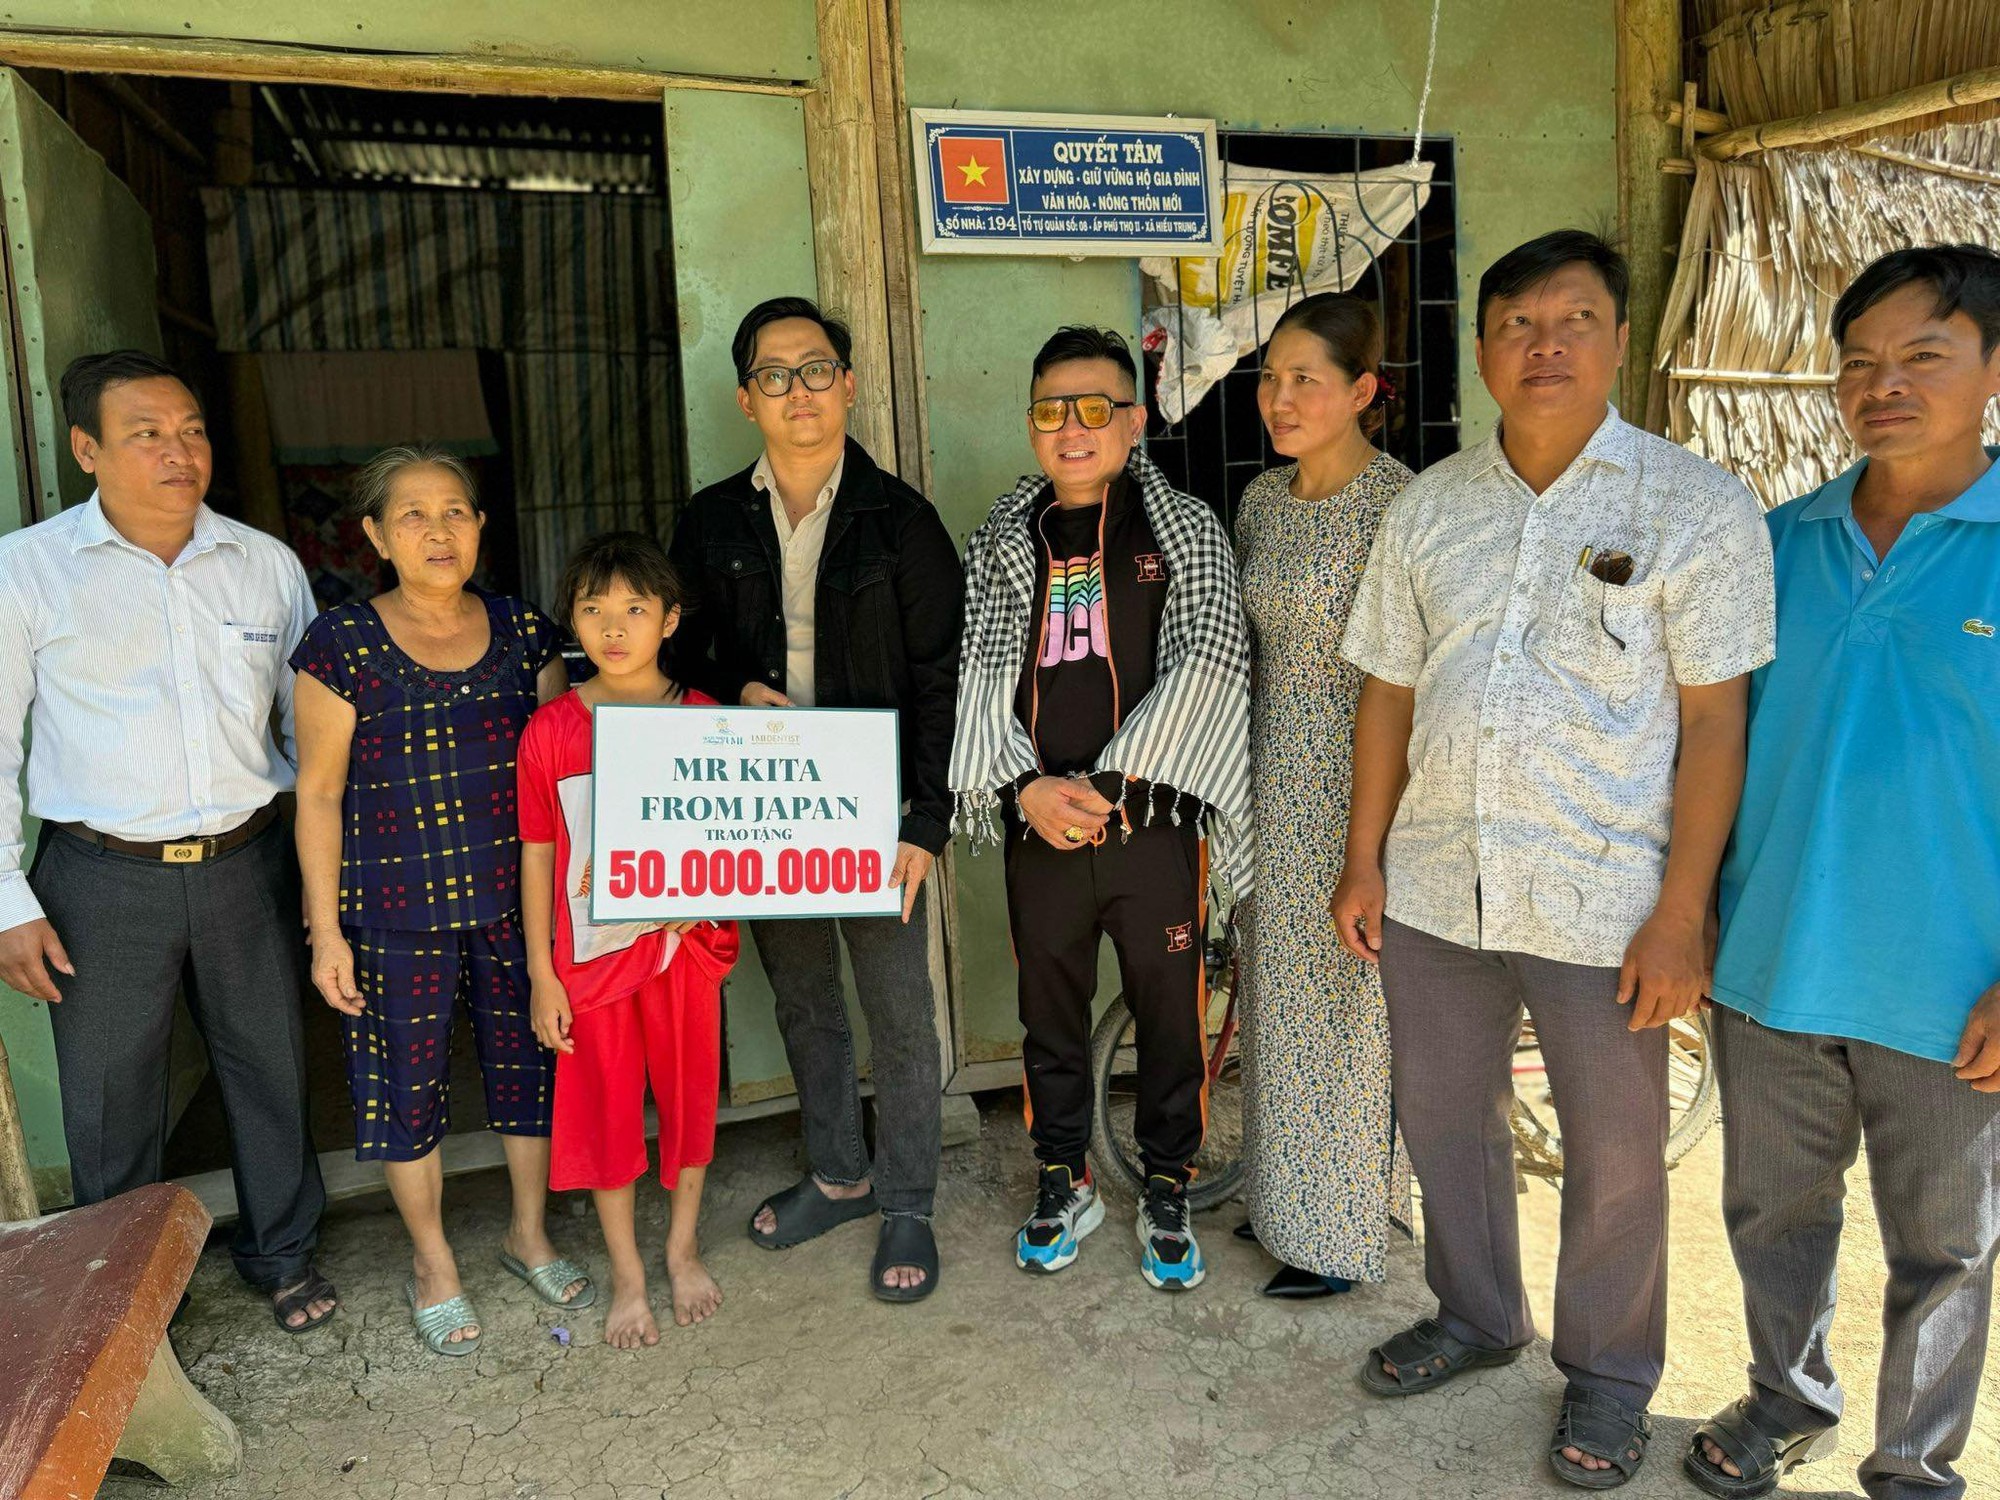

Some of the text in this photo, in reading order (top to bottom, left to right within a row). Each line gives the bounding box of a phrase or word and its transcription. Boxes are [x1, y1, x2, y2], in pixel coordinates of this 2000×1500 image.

[1053, 135, 1163, 164] QUYẾT TÂM
[1018, 166, 1200, 190] XÂY DỰNG GIỮ VỮNG HỘ GIA ĐÌNH
[1041, 191, 1182, 211] VĂN HÓA NÔNG THÔN MỚI
[945, 213, 1018, 231] SỐ NHÀ: 194
[1173, 221, 1197, 233] TRUNG
[673, 757, 821, 782] MR KITA
[640, 796, 859, 822] FROM JAPAN
[704, 825, 792, 843] TRAO TẶNG
[608, 847, 882, 899] 50.000.000Đ
